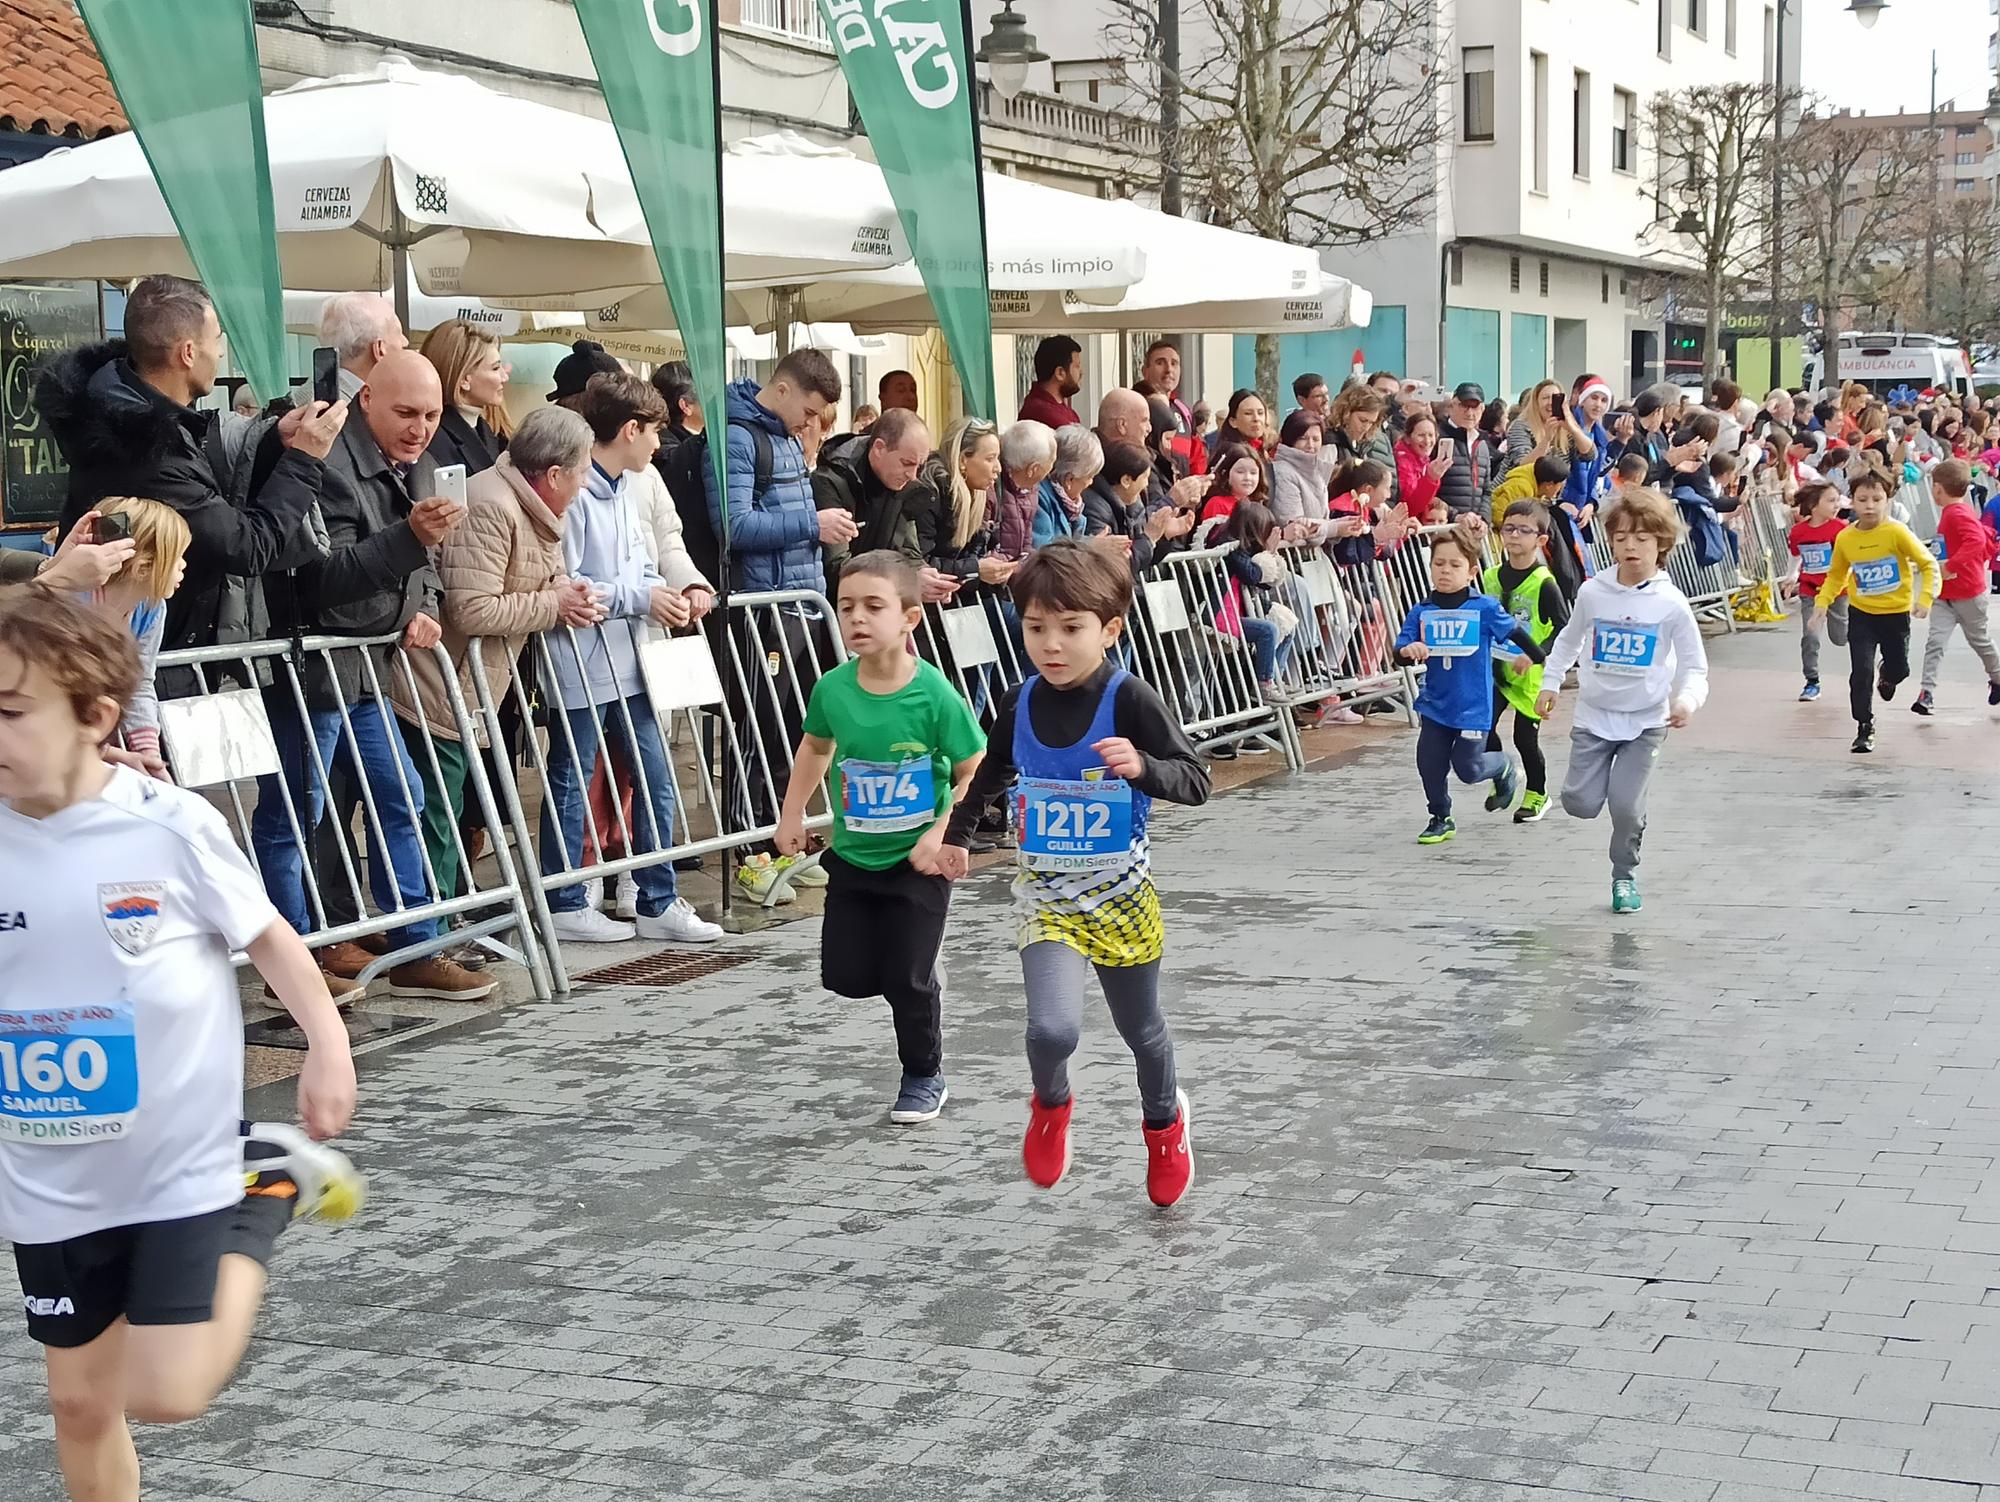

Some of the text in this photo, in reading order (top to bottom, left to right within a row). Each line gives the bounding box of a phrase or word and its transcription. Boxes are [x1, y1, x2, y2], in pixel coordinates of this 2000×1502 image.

[304, 187, 351, 202] CERVEZAS
[300, 205, 352, 221] ALHAMBRA
[857, 226, 890, 241] CERVEZAS
[851, 240, 893, 256] ALHAMBRA
[1002, 257, 1044, 274] más
[1052, 256, 1114, 276] limpio
[991, 289, 1029, 301] CERVEZAS
[1285, 301, 1323, 311] CERVEZAS
[456, 308, 503, 322] Mahou
[1283, 312, 1324, 321] ALHAMBRA
[600, 339, 642, 354] respires
[645, 344, 667, 356] más
[1803, 550, 1826, 564] 1151
[1855, 564, 1894, 583] 1228
[1432, 620, 1469, 638] 1117
[1600, 631, 1647, 657] 1213
[852, 773, 920, 805] 1174
[1033, 800, 1112, 838] 1212
[1046, 840, 1094, 851] GUILLE
[1054, 856, 1119, 869] PDMSiero
[0, 1037, 109, 1093] 160
[3, 1095, 87, 1113] SAMUEL
[20, 1120, 122, 1139] PDMSiero
